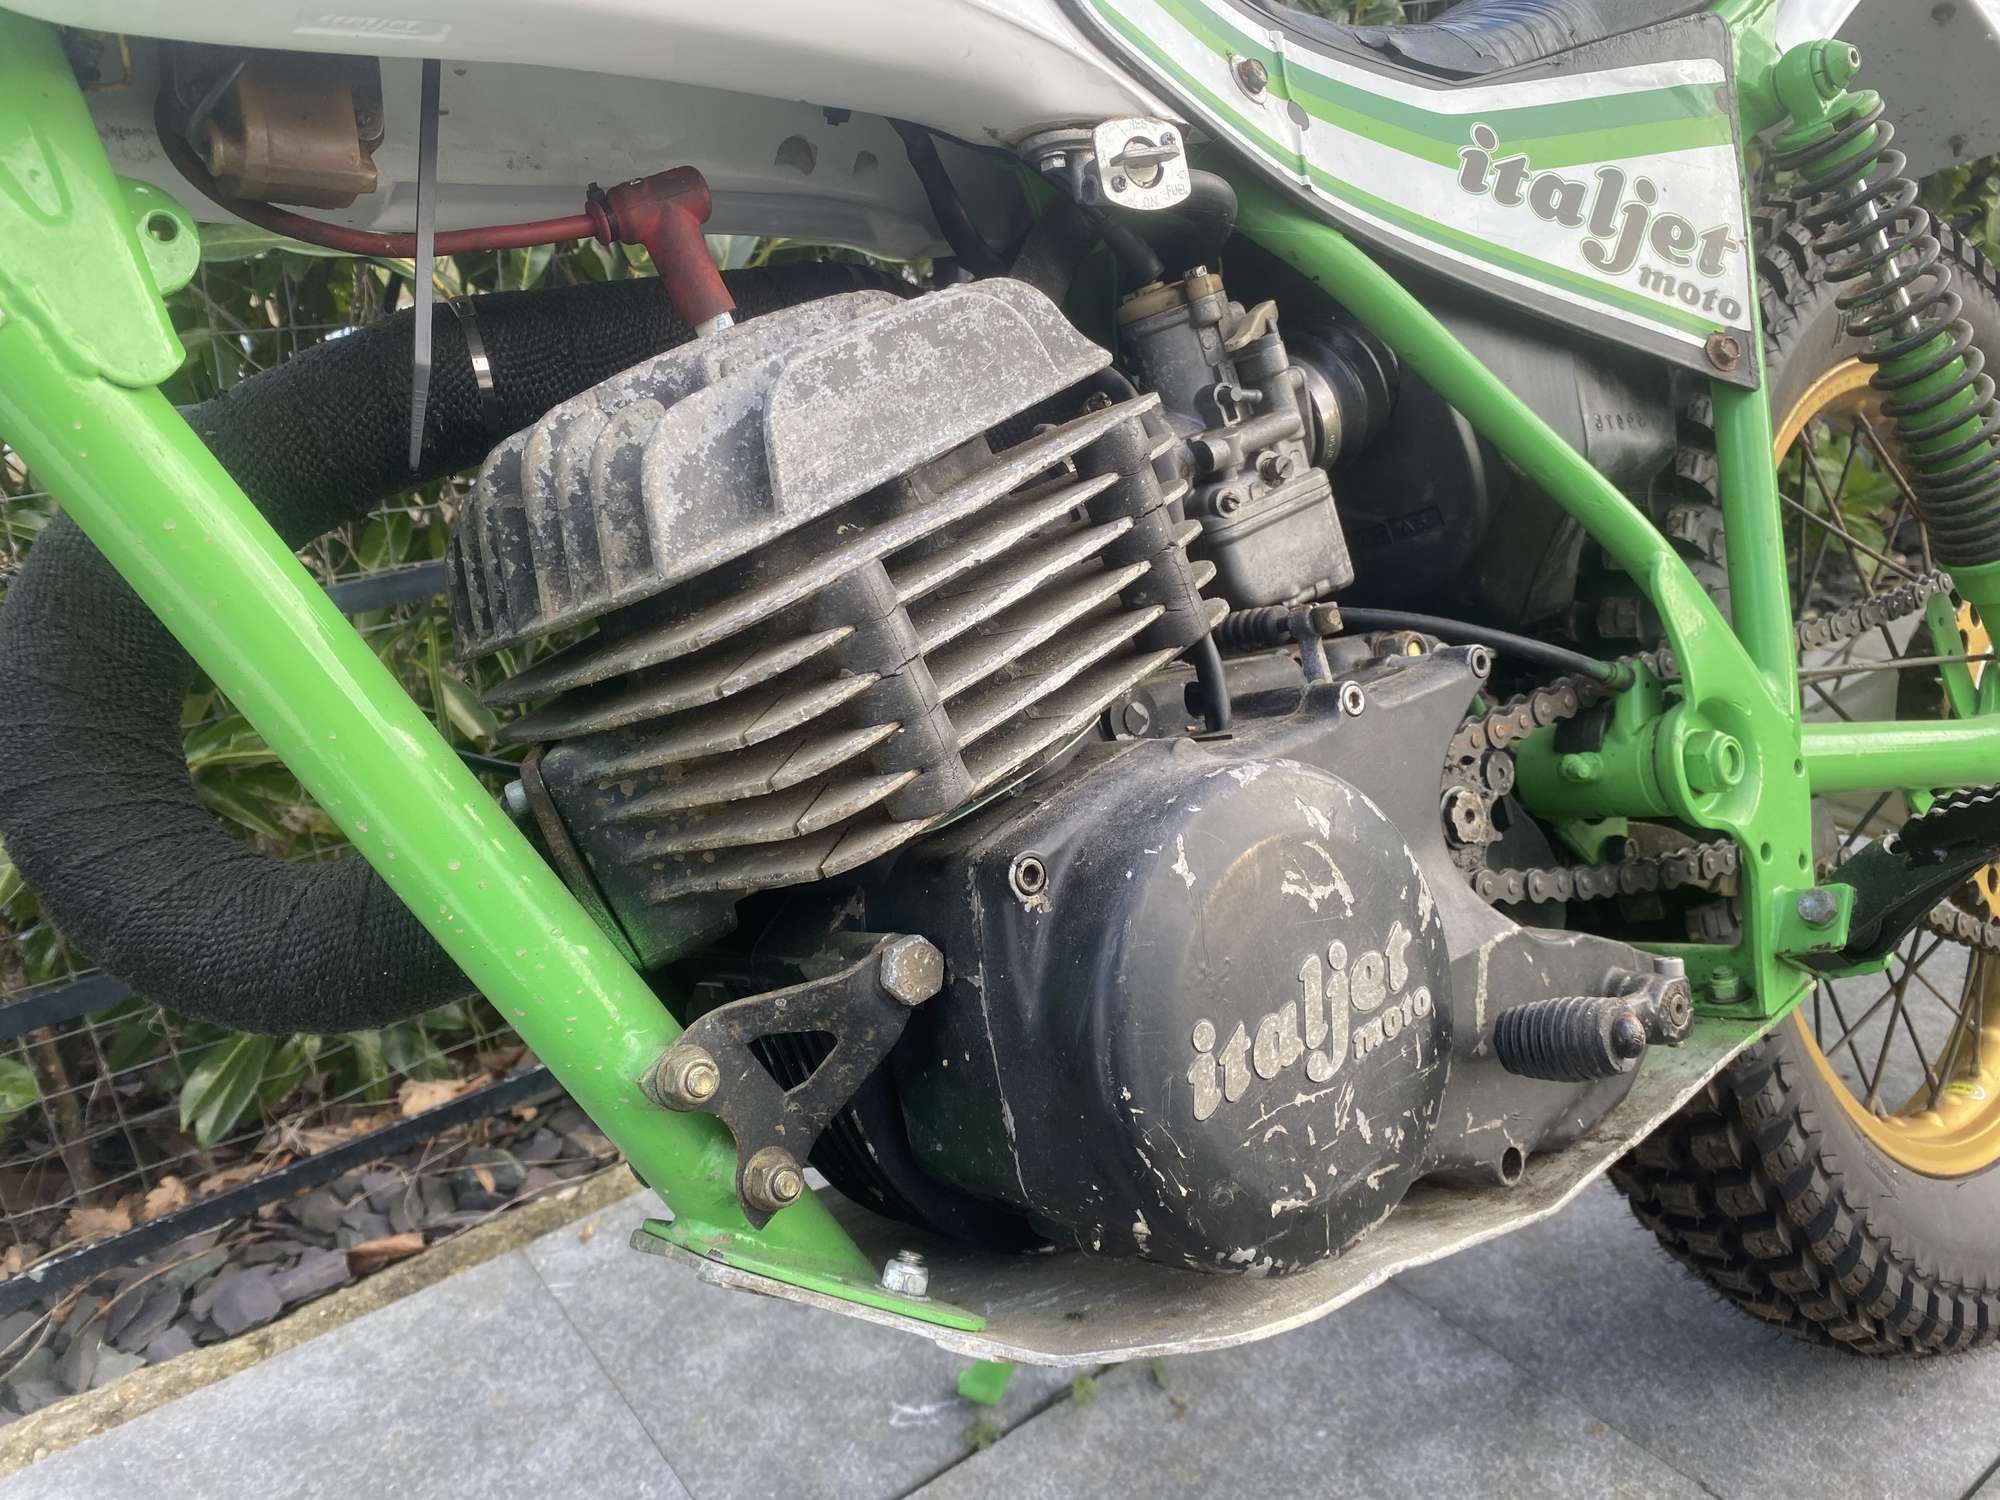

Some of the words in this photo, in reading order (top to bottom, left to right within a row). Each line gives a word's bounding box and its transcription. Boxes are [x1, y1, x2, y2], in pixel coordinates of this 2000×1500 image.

[1166, 184, 1188, 199] FUEL
[1458, 123, 1737, 276] italjet
[1640, 264, 1742, 320] moto
[1187, 920, 1412, 1121] italjet
[1352, 986, 1432, 1060] moto
